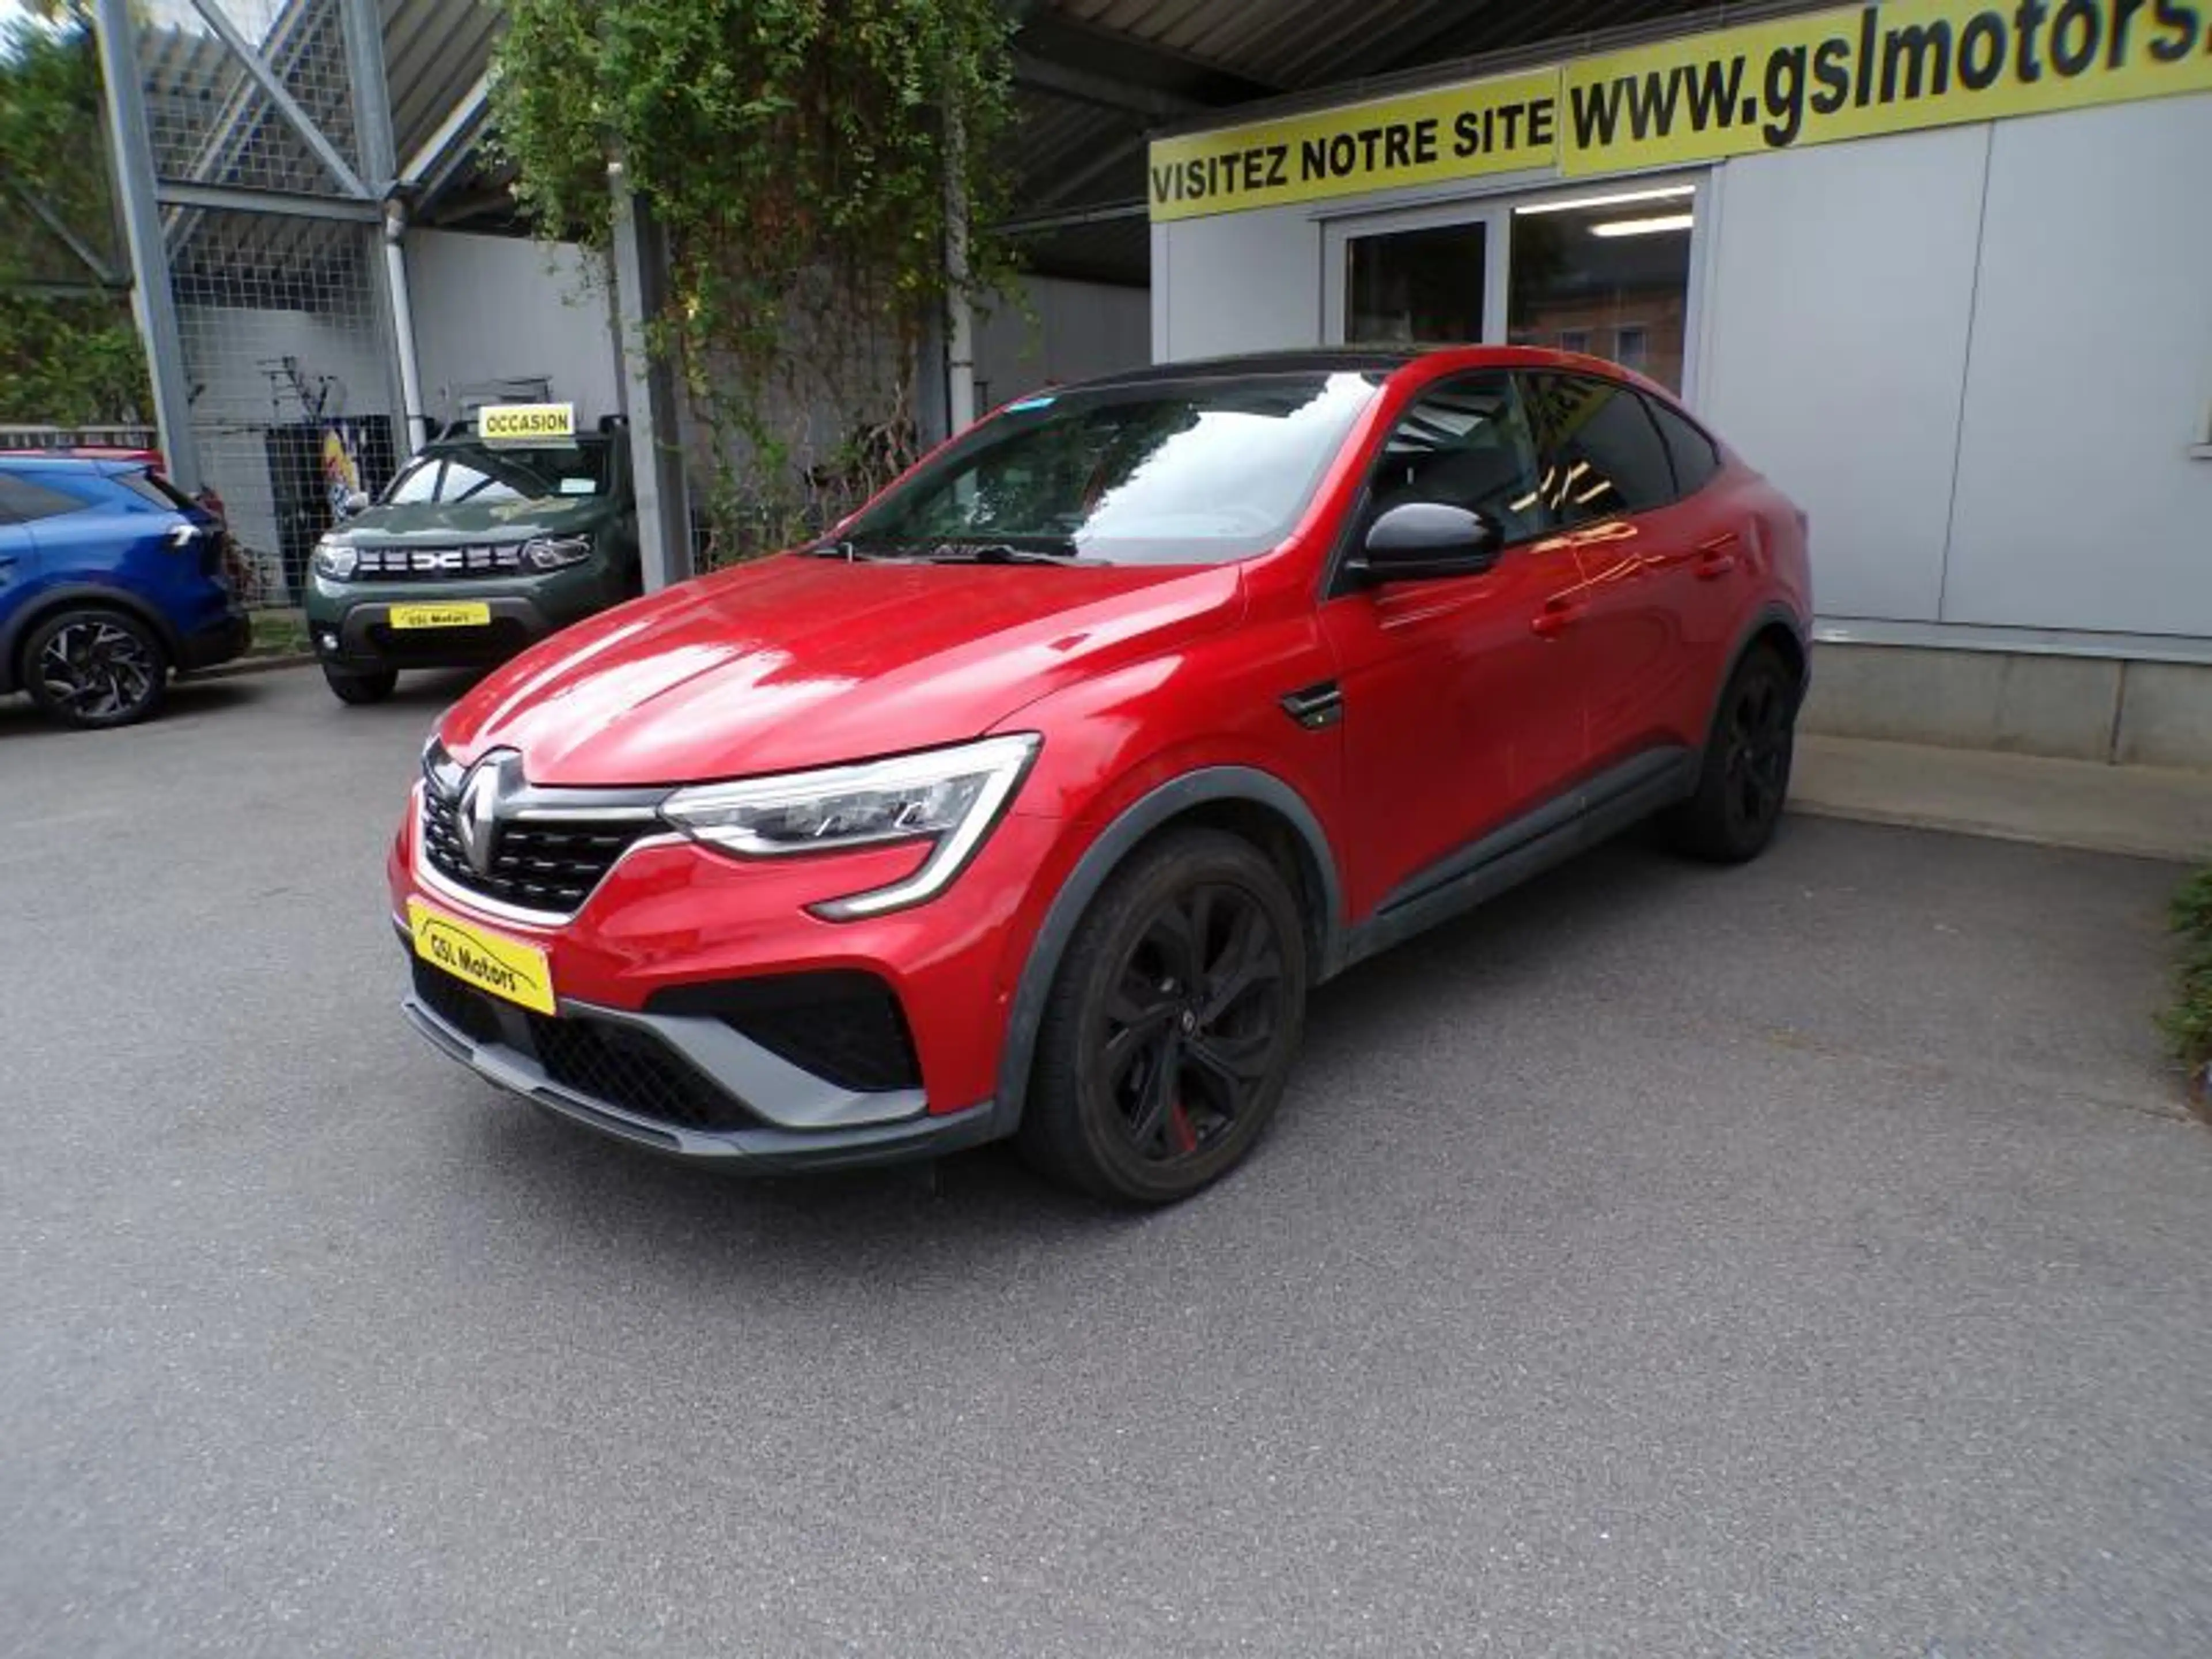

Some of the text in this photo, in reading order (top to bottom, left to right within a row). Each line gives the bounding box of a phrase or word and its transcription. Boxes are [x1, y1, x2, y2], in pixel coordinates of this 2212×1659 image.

[1152, 144, 1288, 203] VISITEZ
[1301, 119, 1438, 180] NOTRE
[1454, 98, 1555, 158] SITE
[487, 414, 567, 433] OCCASION
[431, 934, 516, 993] GSL Motors
